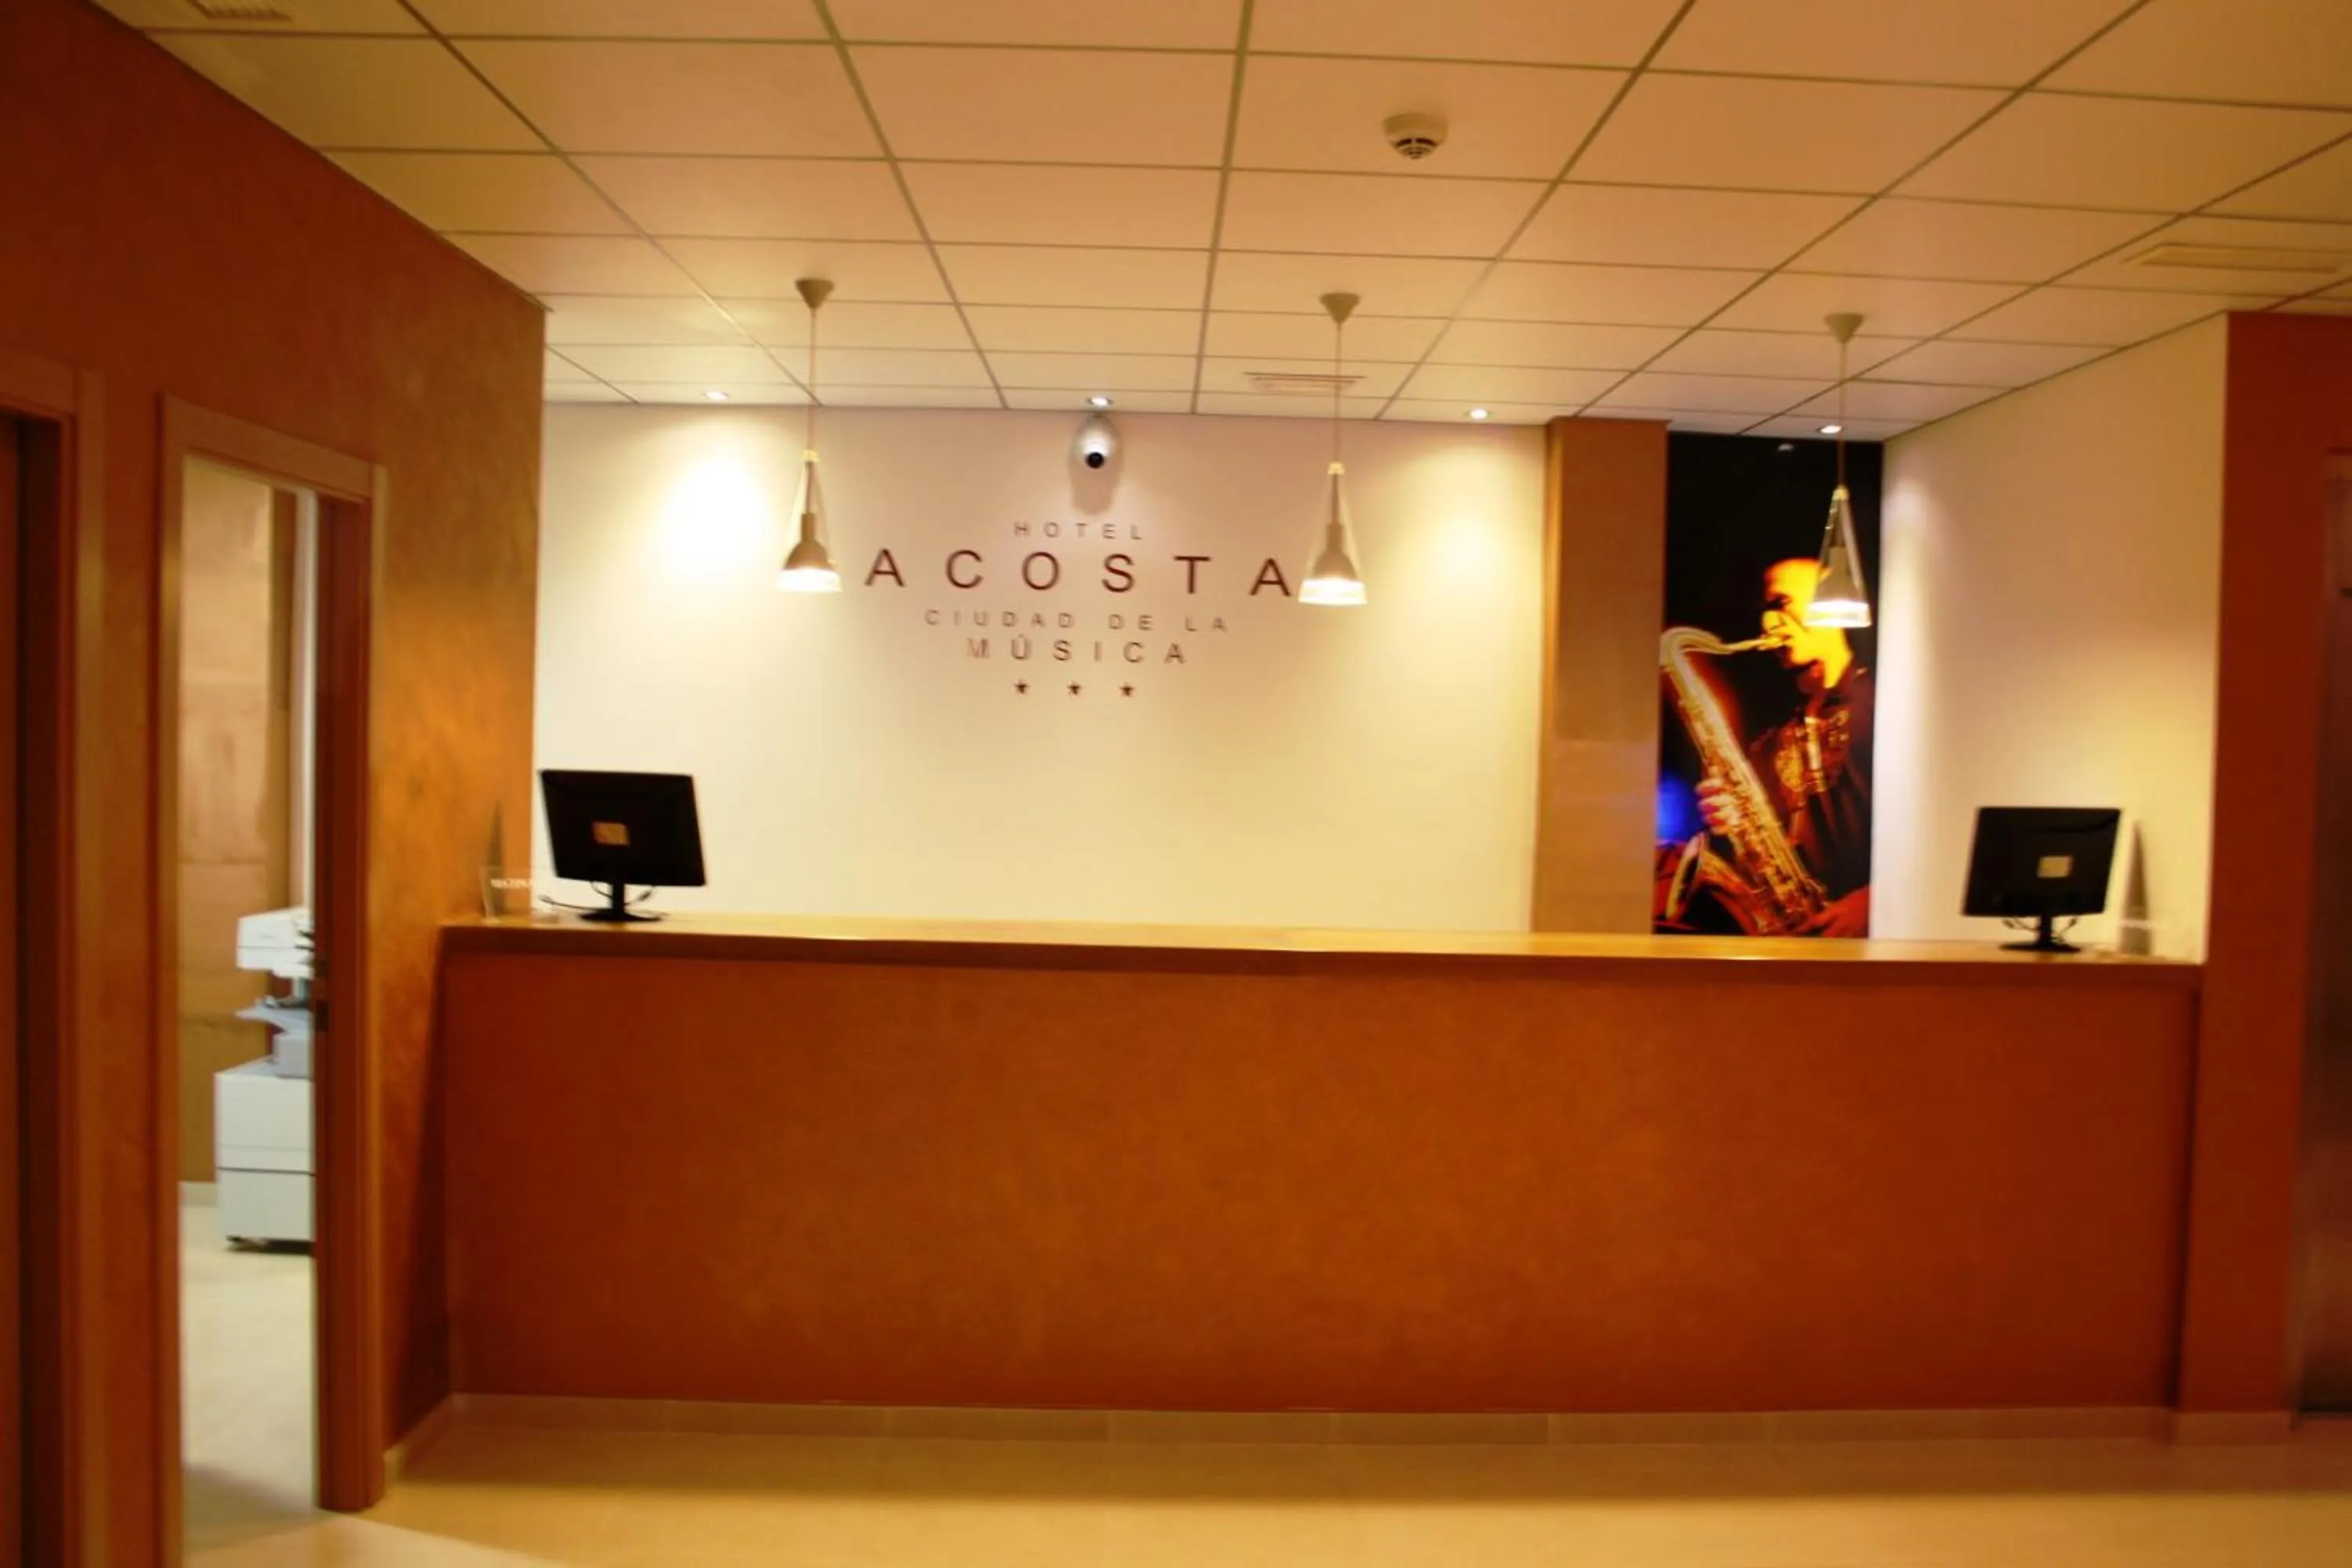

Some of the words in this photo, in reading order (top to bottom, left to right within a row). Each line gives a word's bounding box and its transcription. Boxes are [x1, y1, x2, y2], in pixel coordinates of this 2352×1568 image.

[1014, 521, 1142, 540] HOTEL
[865, 548, 1292, 597] ACOSTA
[924, 608, 1073, 629] CIUDAD
[1108, 614, 1153, 631] DE
[1185, 615, 1228, 633] LA
[965, 633, 1187, 664] MÚSICA
